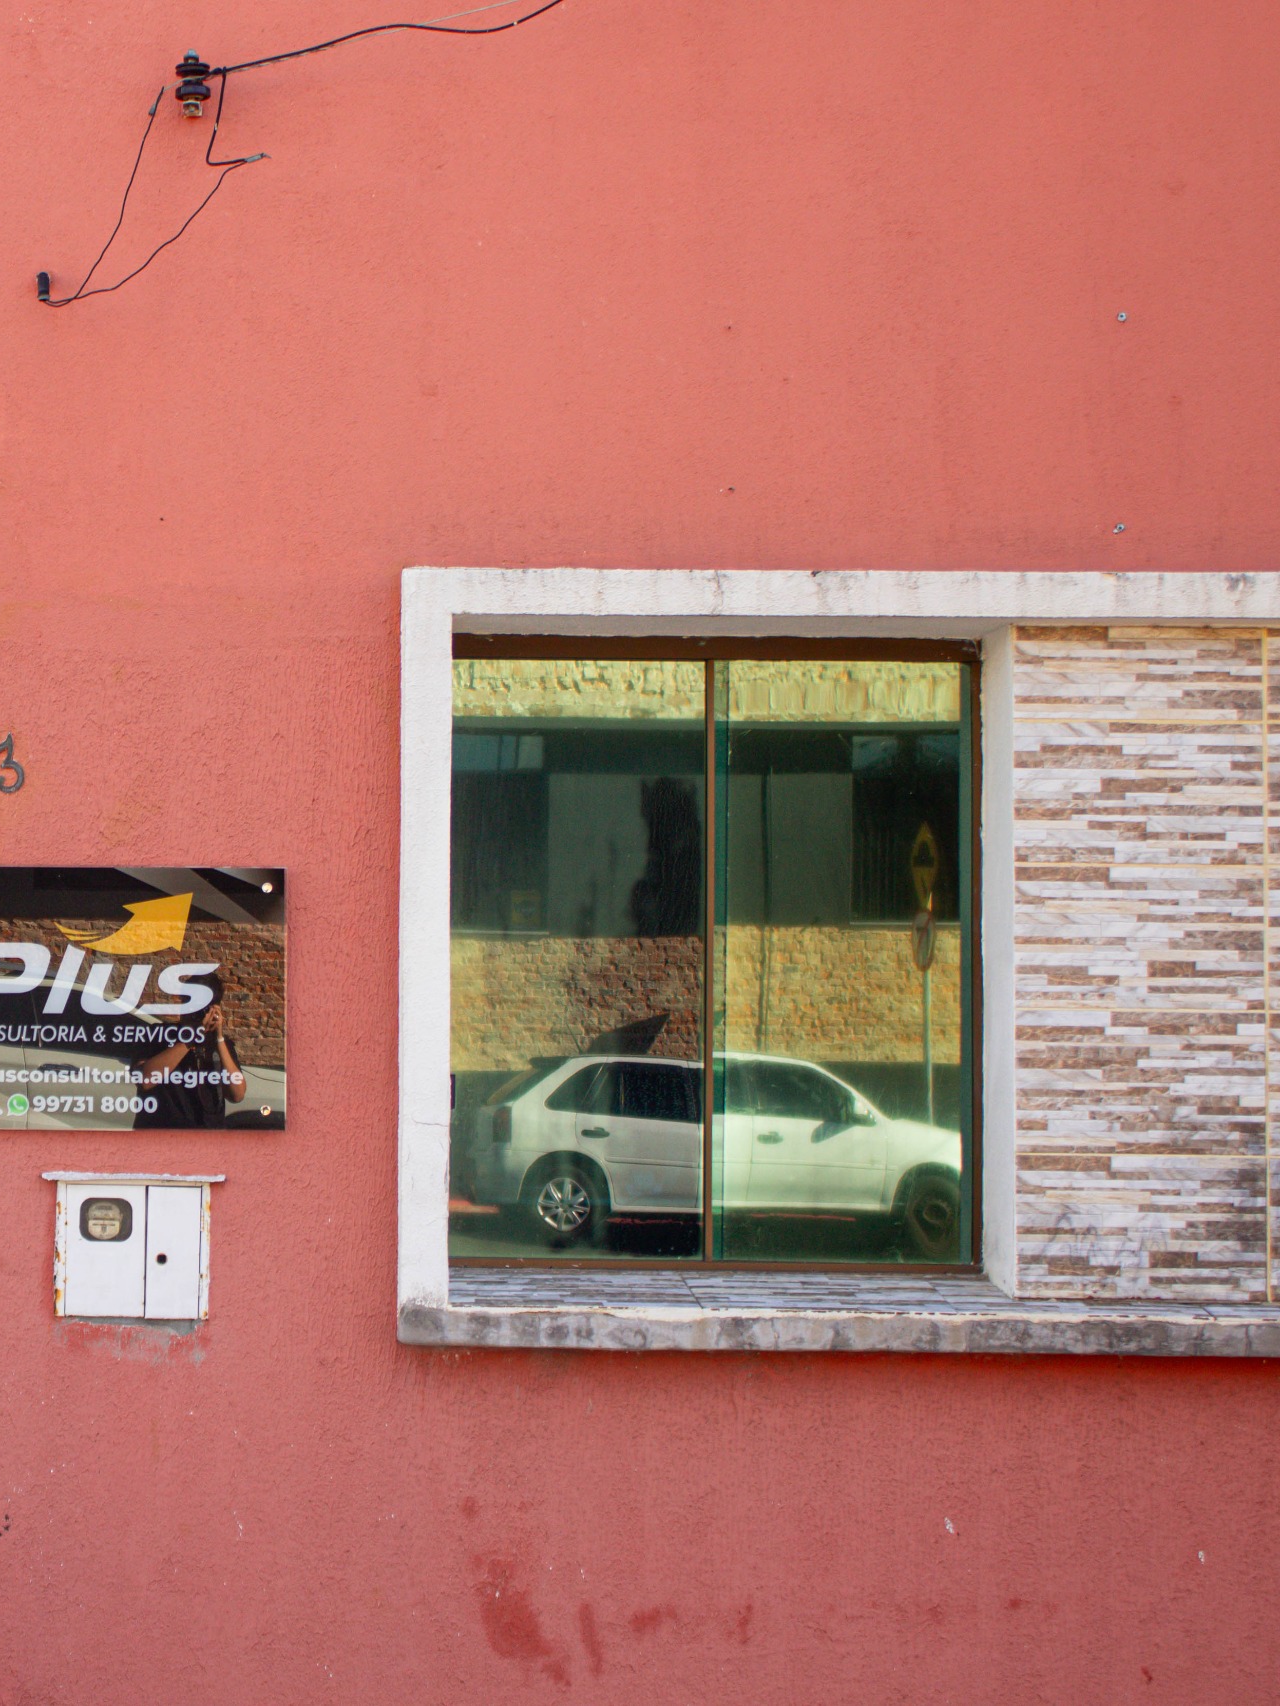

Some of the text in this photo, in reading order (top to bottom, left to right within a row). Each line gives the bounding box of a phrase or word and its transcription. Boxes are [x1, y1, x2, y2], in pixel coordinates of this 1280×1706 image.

[93, 1025, 106, 1042] &
[112, 1026, 206, 1047] SERVIÇOS
[33, 1096, 158, 1114] 99731 8000
